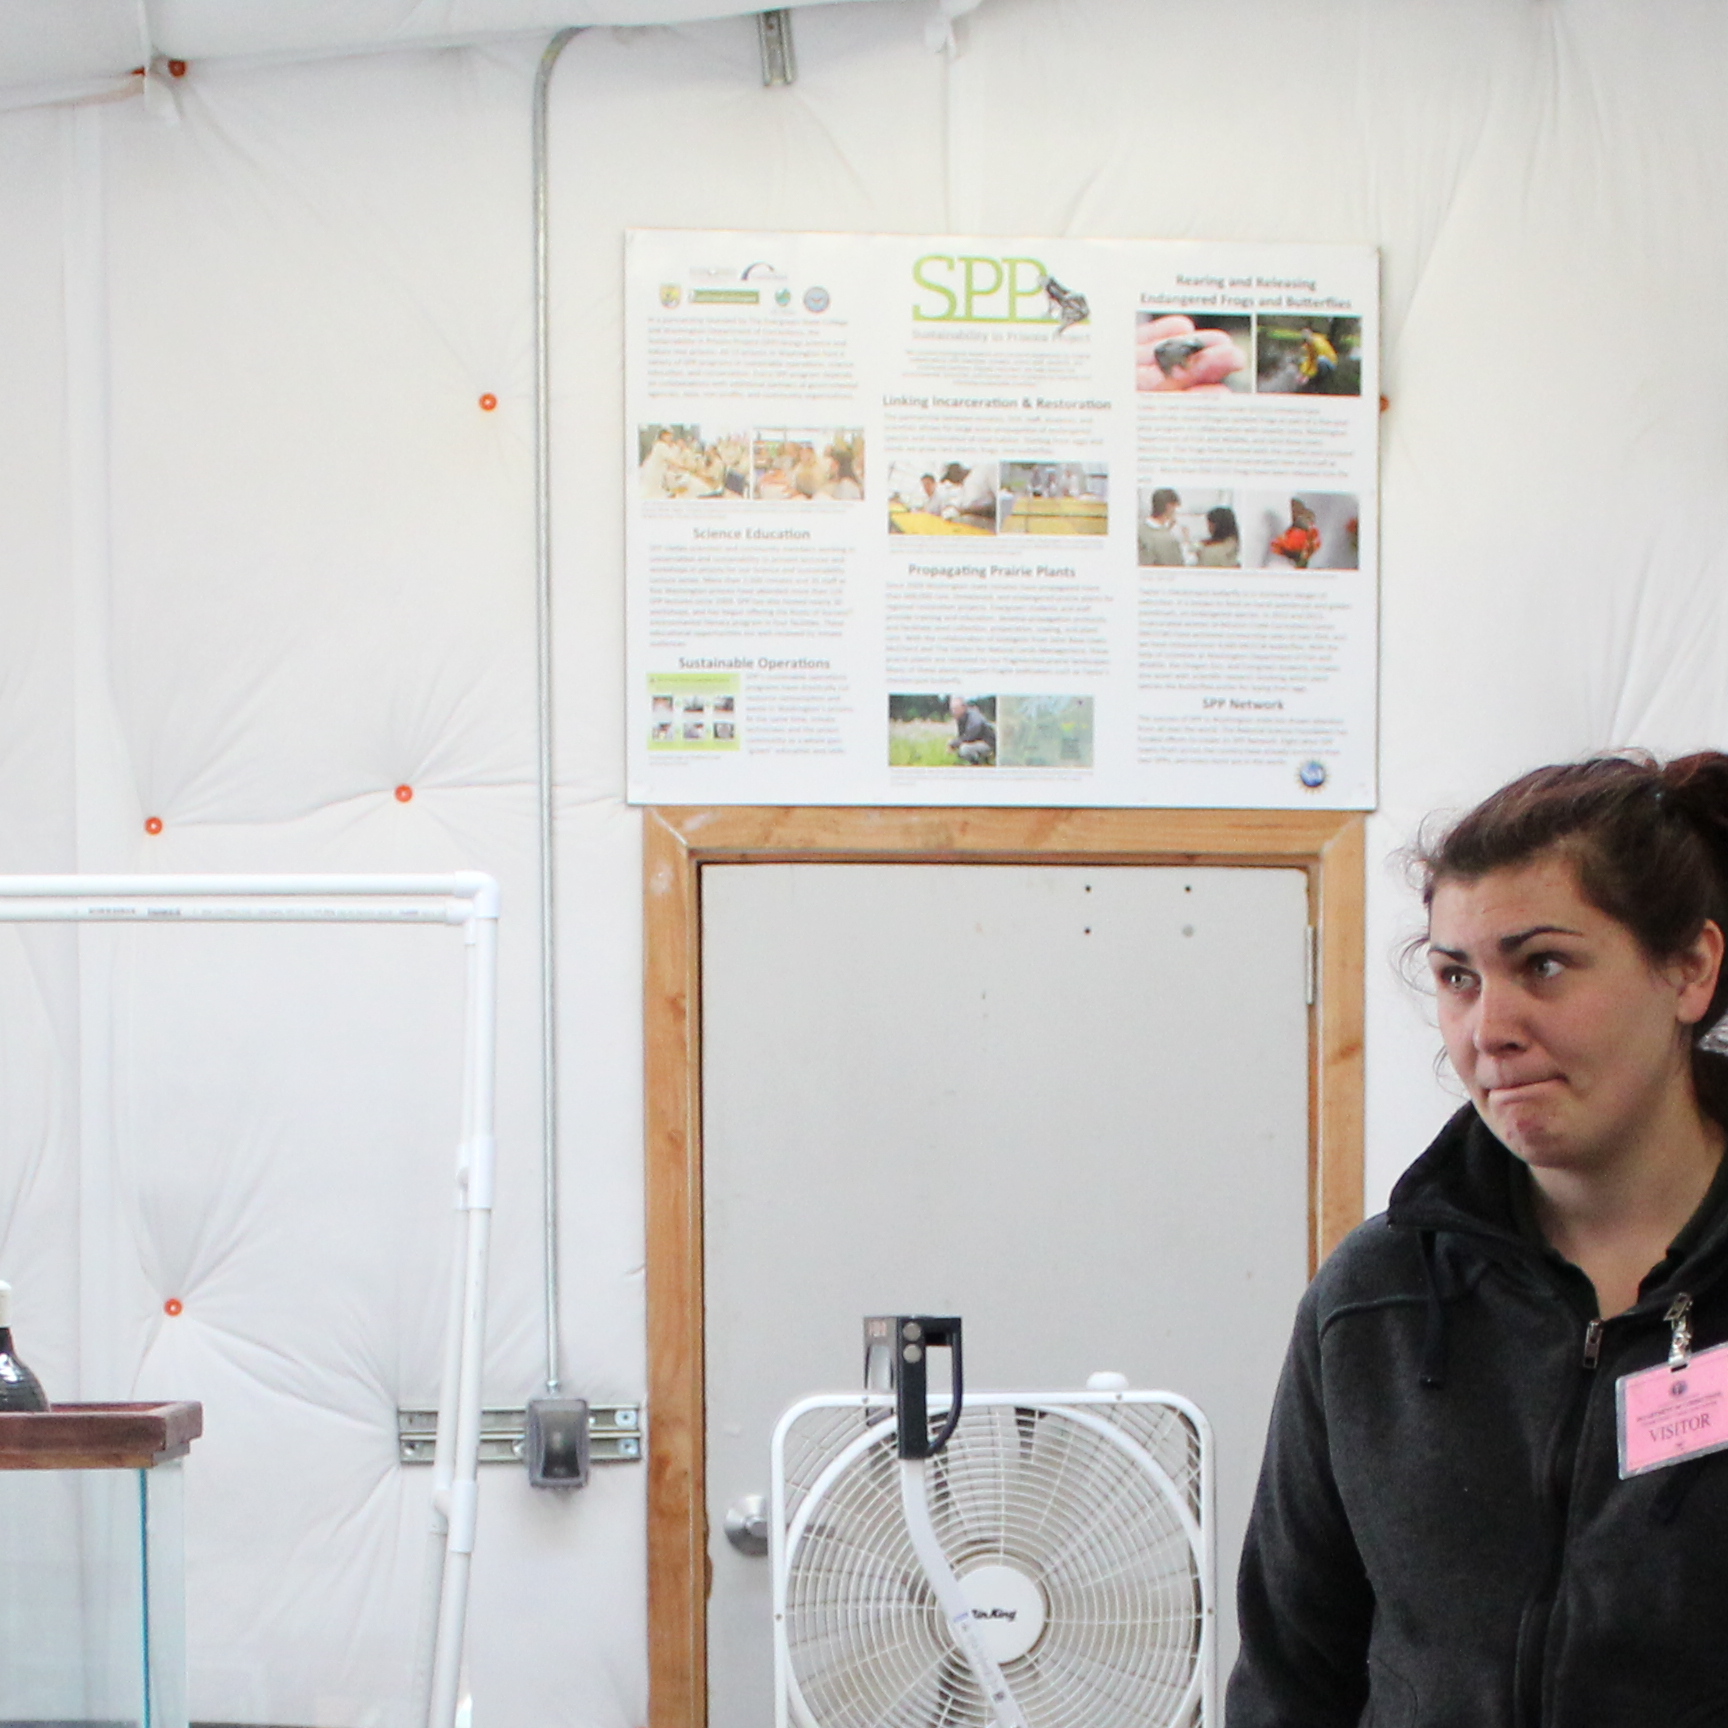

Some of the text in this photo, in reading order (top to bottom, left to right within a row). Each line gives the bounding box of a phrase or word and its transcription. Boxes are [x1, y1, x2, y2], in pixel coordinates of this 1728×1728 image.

[912, 251, 1049, 323] SPP
[1176, 273, 1316, 291] Rearing and Releasing
[1140, 292, 1352, 308] Endangered Frogs and Butterflies
[912, 329, 988, 344] Sustainability
[991, 331, 1004, 342] in
[882, 393, 1112, 409] Linking Incarceration & Restoration
[692, 526, 812, 540] Science Education
[908, 562, 1076, 579] Propagating Prairie Plants
[678, 656, 830, 672] Sustainable Operations
[1202, 696, 1284, 710] SPP Network
[1649, 1412, 1711, 1442] VISITOR
